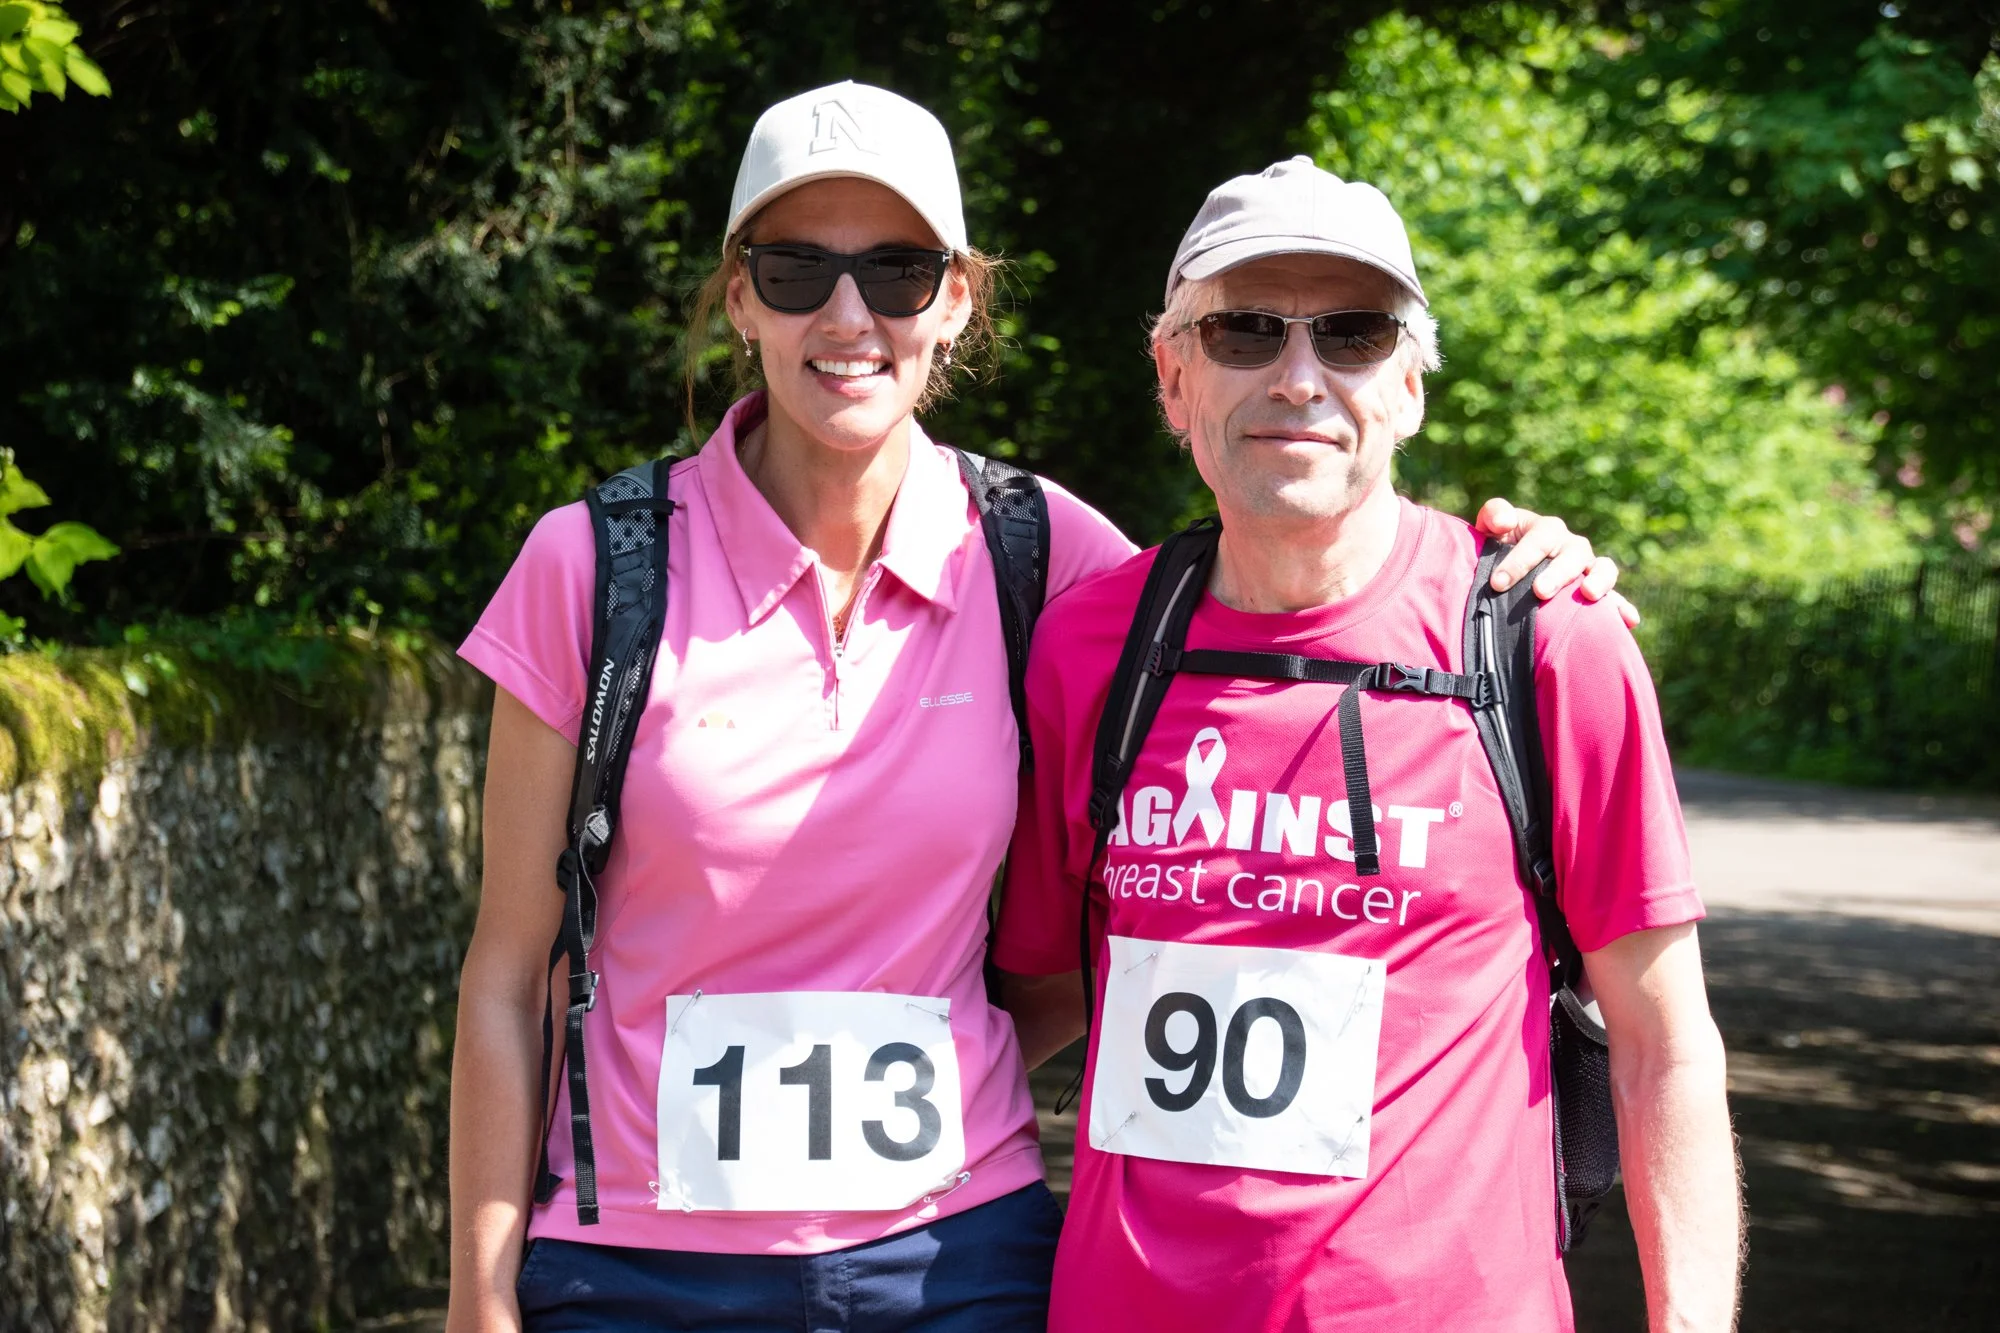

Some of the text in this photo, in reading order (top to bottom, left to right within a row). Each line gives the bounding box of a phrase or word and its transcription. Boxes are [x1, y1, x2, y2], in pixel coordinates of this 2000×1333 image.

[586, 658, 615, 765] SALOMON
[919, 692, 974, 708] ELLESSE
[1227, 871, 1421, 926] cancer
[692, 1042, 942, 1162] 113
[1143, 991, 1307, 1119] 90
